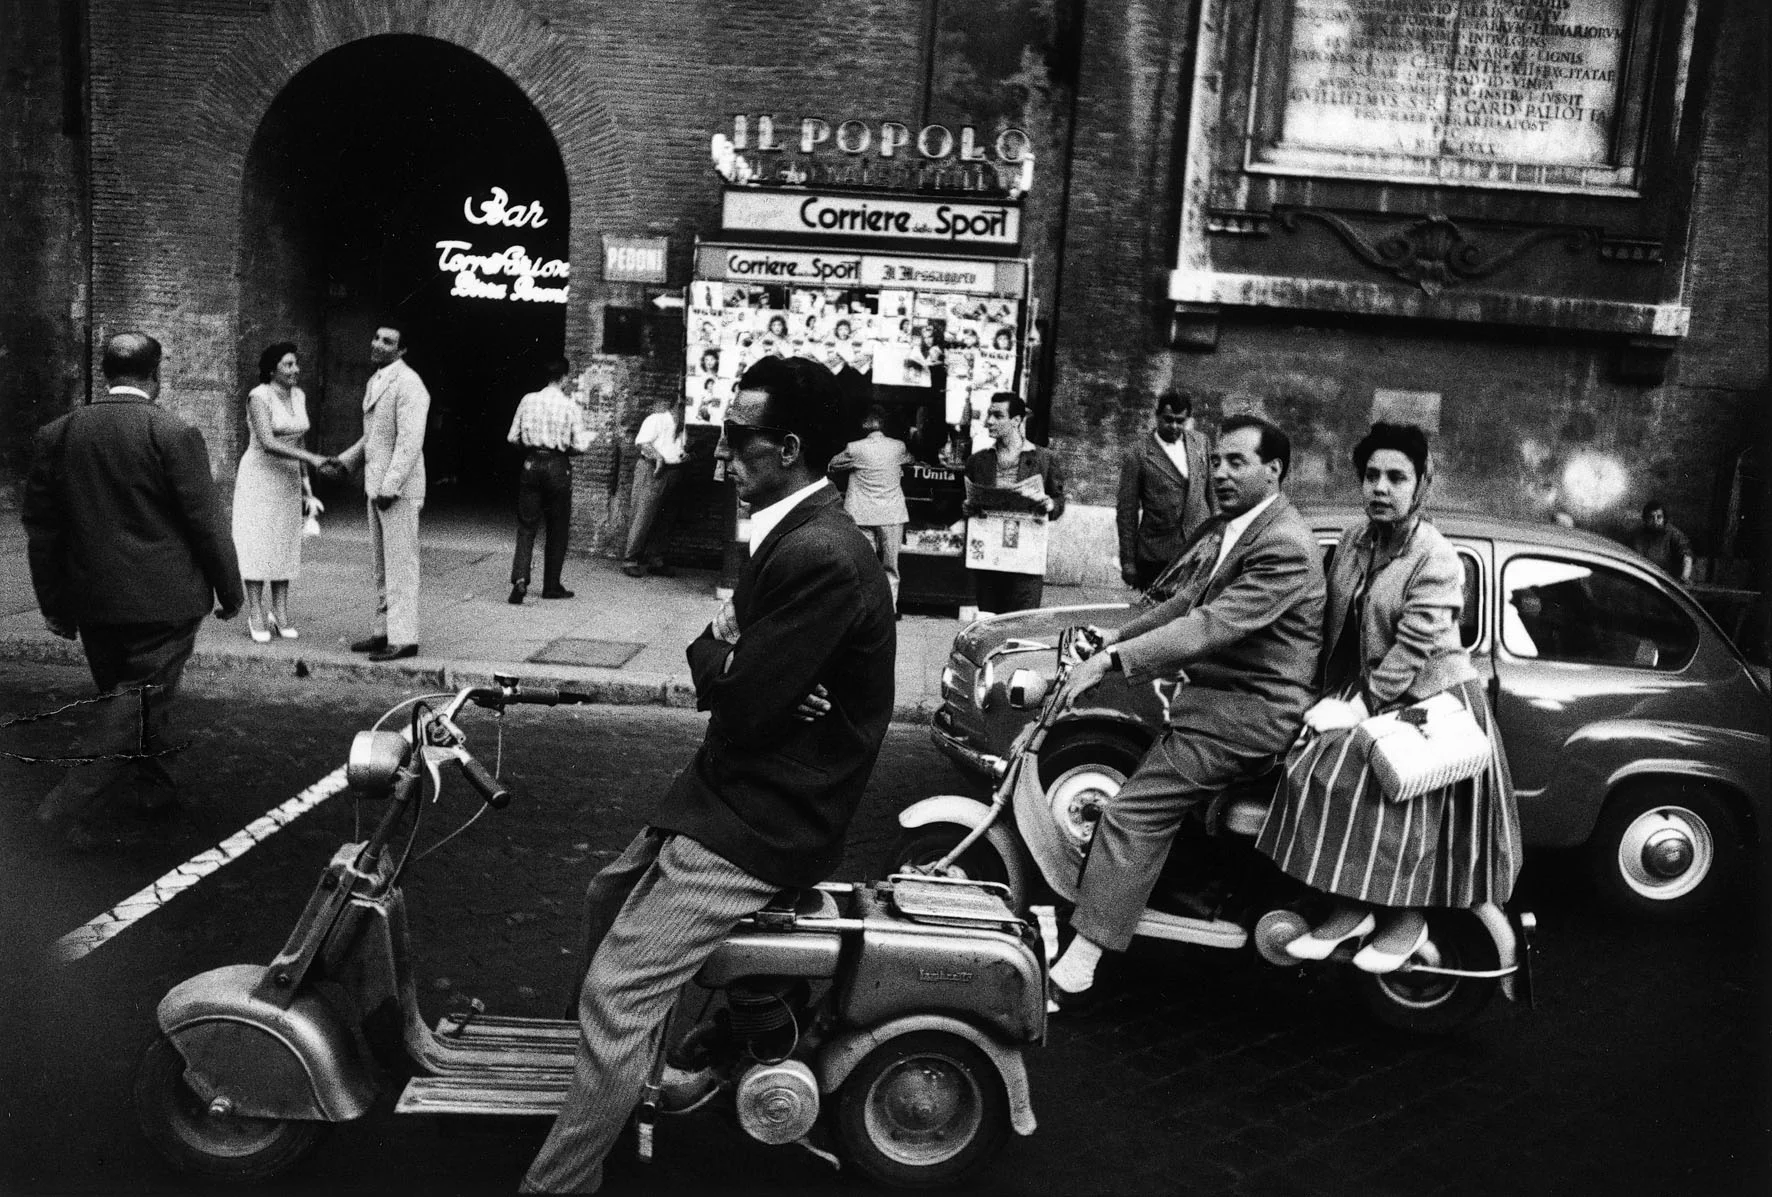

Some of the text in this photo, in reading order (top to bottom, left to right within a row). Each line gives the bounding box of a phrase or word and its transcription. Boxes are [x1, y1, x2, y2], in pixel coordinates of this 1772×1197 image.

[735, 115, 1031, 163] IL POPOLO
[464, 186, 548, 229] Bar
[800, 197, 911, 233] Corriere
[934, 206, 1007, 240] Sport
[728, 255, 860, 281] Corriere Sport
